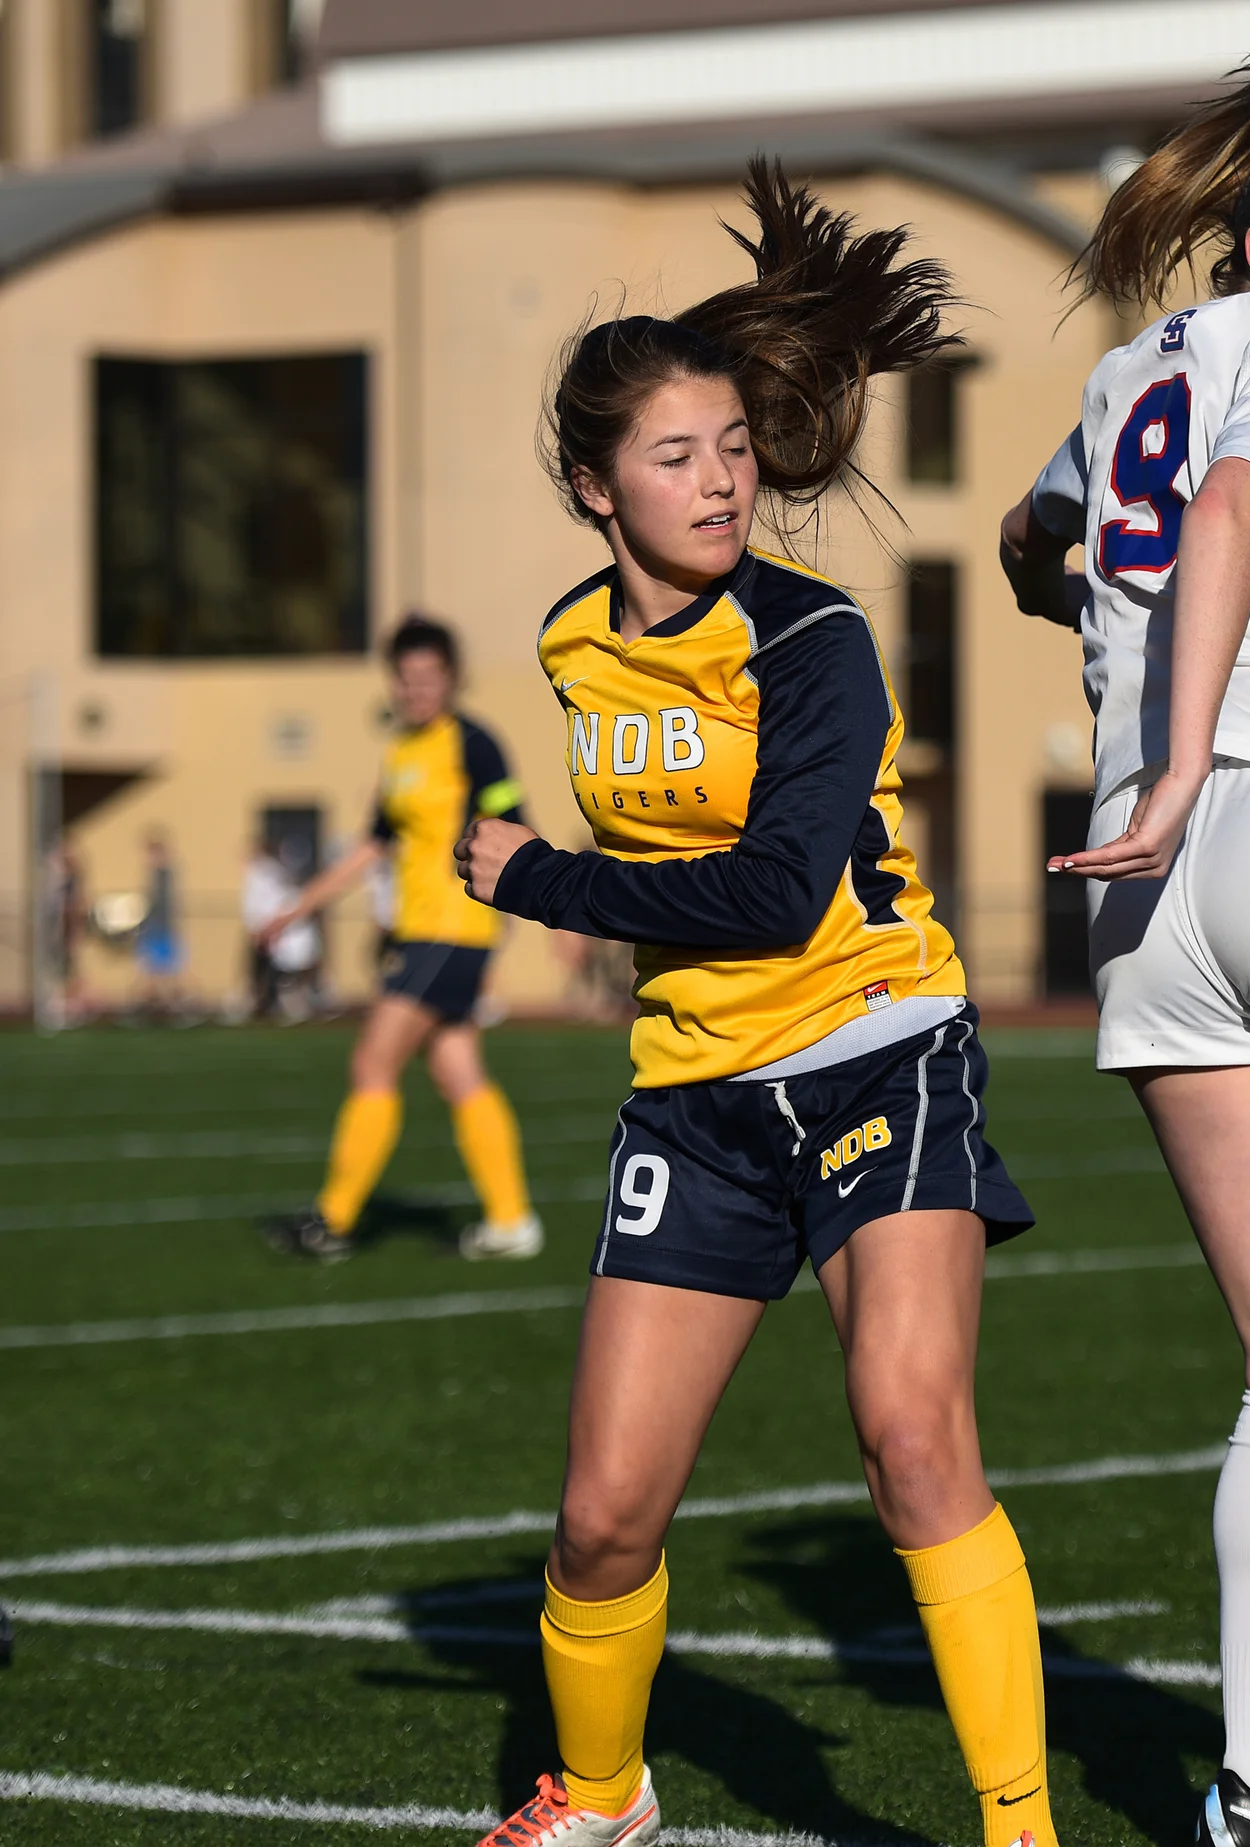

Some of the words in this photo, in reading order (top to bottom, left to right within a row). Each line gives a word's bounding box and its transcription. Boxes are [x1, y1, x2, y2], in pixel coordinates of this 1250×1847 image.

[1098, 371, 1192, 580] 9
[571, 706, 705, 776] NDB
[867, 990, 886, 999] TEAM
[820, 1115, 893, 1181] NDB
[615, 1153, 670, 1237] 9
